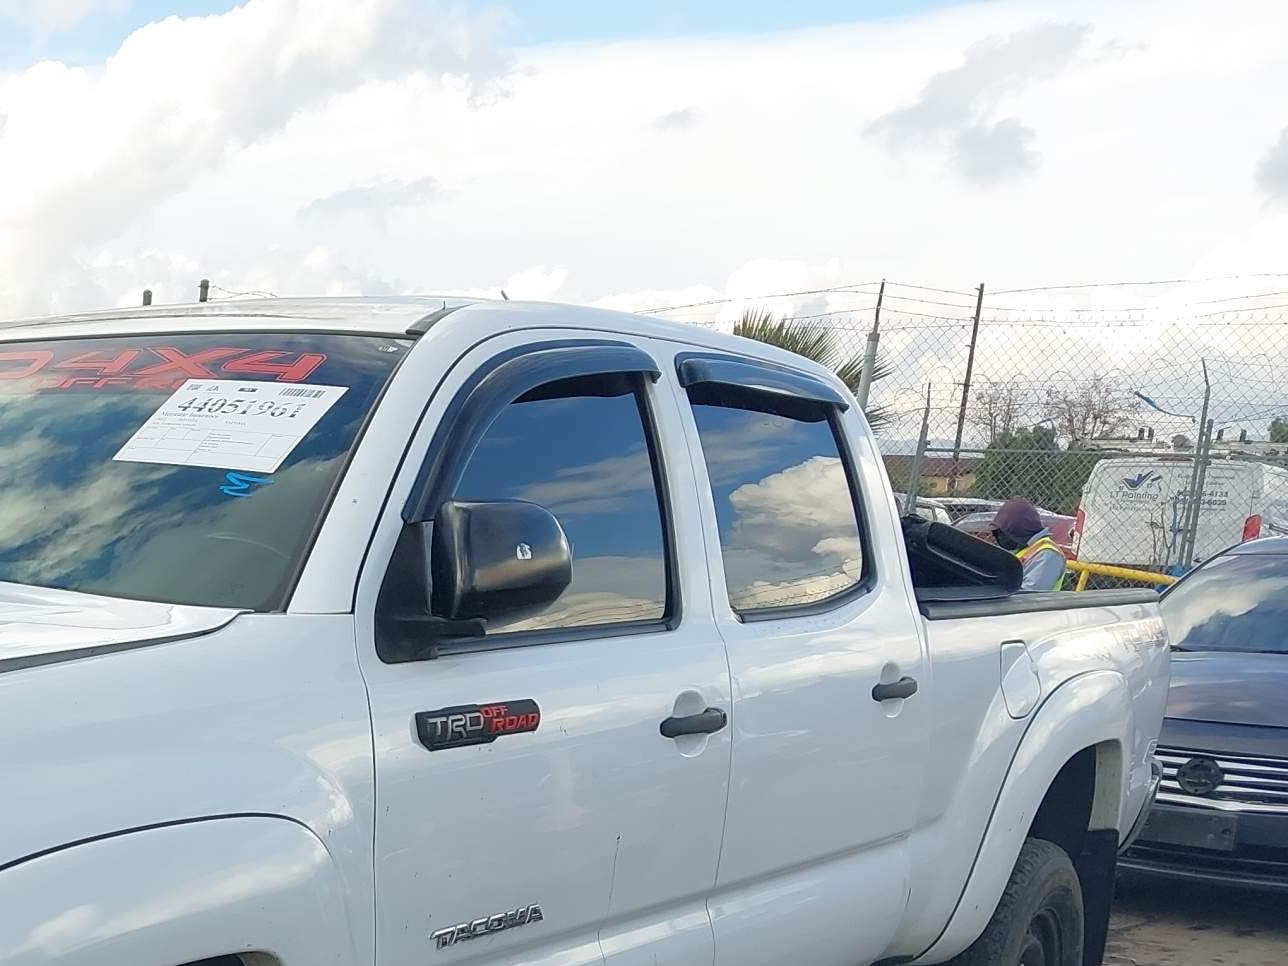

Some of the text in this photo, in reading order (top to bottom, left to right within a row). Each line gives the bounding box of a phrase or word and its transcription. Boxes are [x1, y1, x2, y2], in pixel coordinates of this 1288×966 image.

[53, 346, 328, 382] 4X4
[177, 397, 307, 418] 44051961
[426, 705, 539, 740] TRD OFF ROAD
[429, 904, 545, 950] TACOMA
